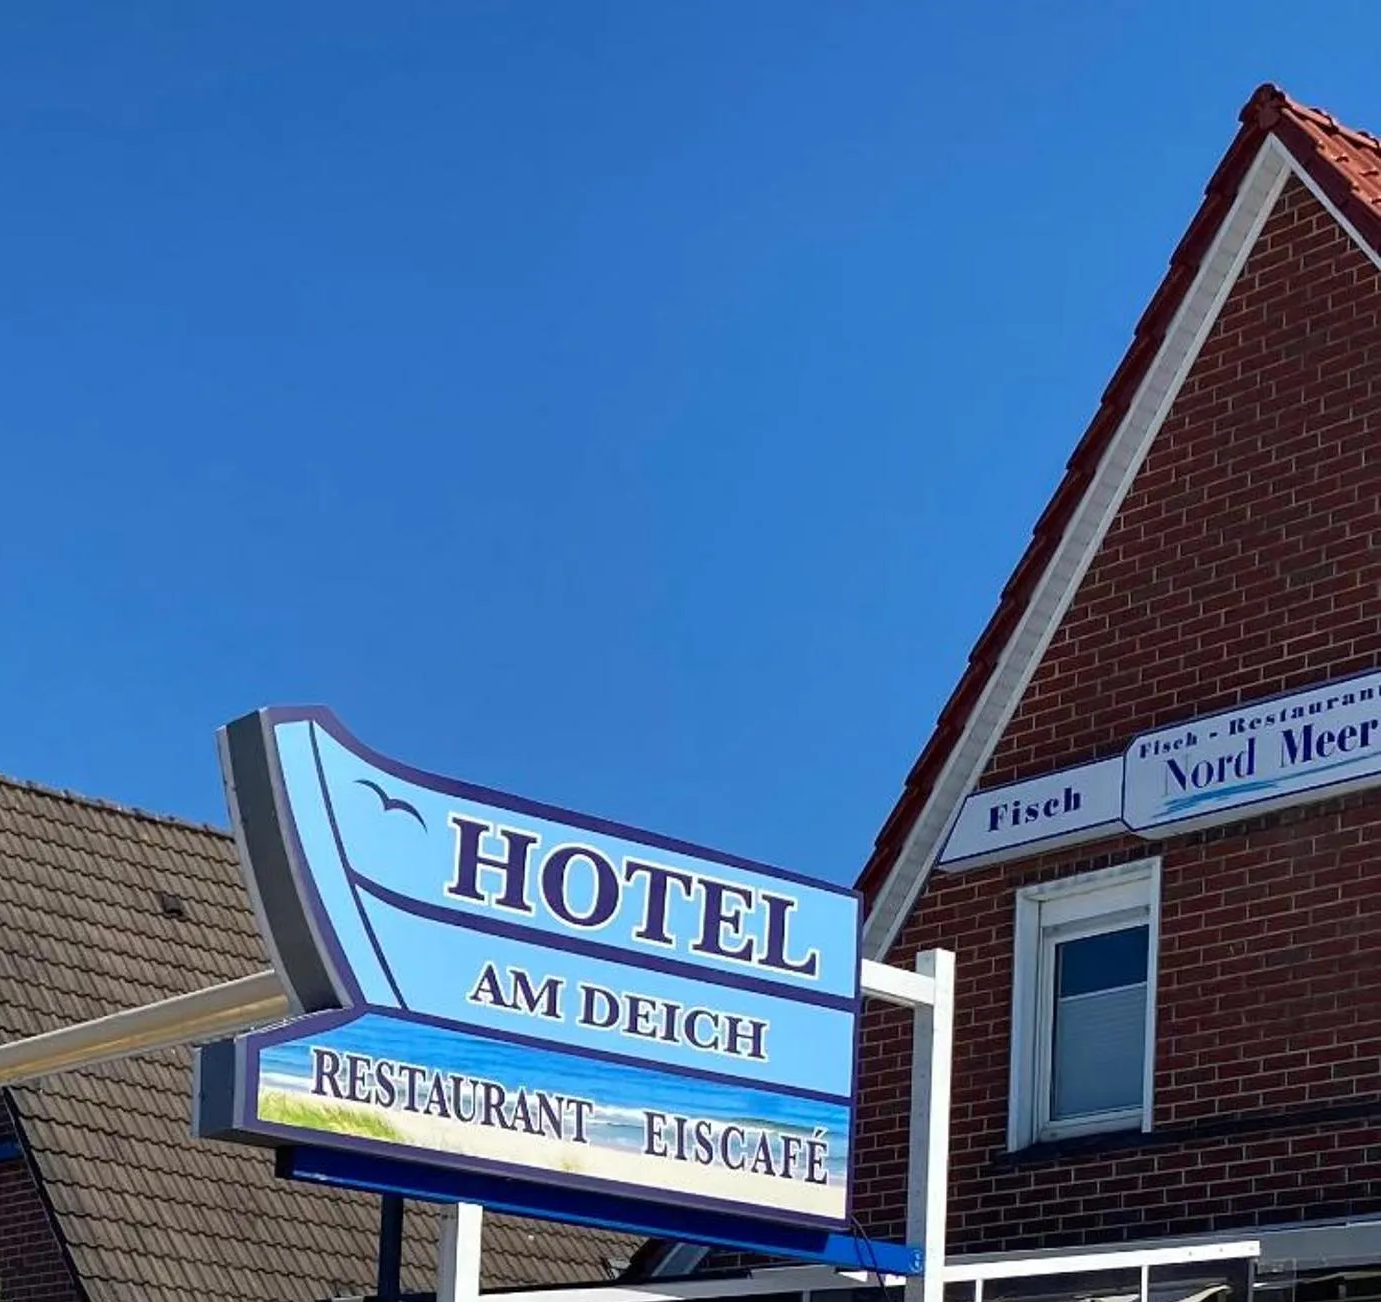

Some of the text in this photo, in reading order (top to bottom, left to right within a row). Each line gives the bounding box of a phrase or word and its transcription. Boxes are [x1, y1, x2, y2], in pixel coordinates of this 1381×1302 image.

[1139, 731, 1198, 759] Fisch
[1164, 719, 1379, 797] Nord Meer
[987, 787, 1082, 832] Fisch
[448, 815, 819, 978] HOTEL
[470, 963, 768, 1060] AM DEICH
[311, 1049, 829, 1186] RESTAURANT EISCAFÉ
